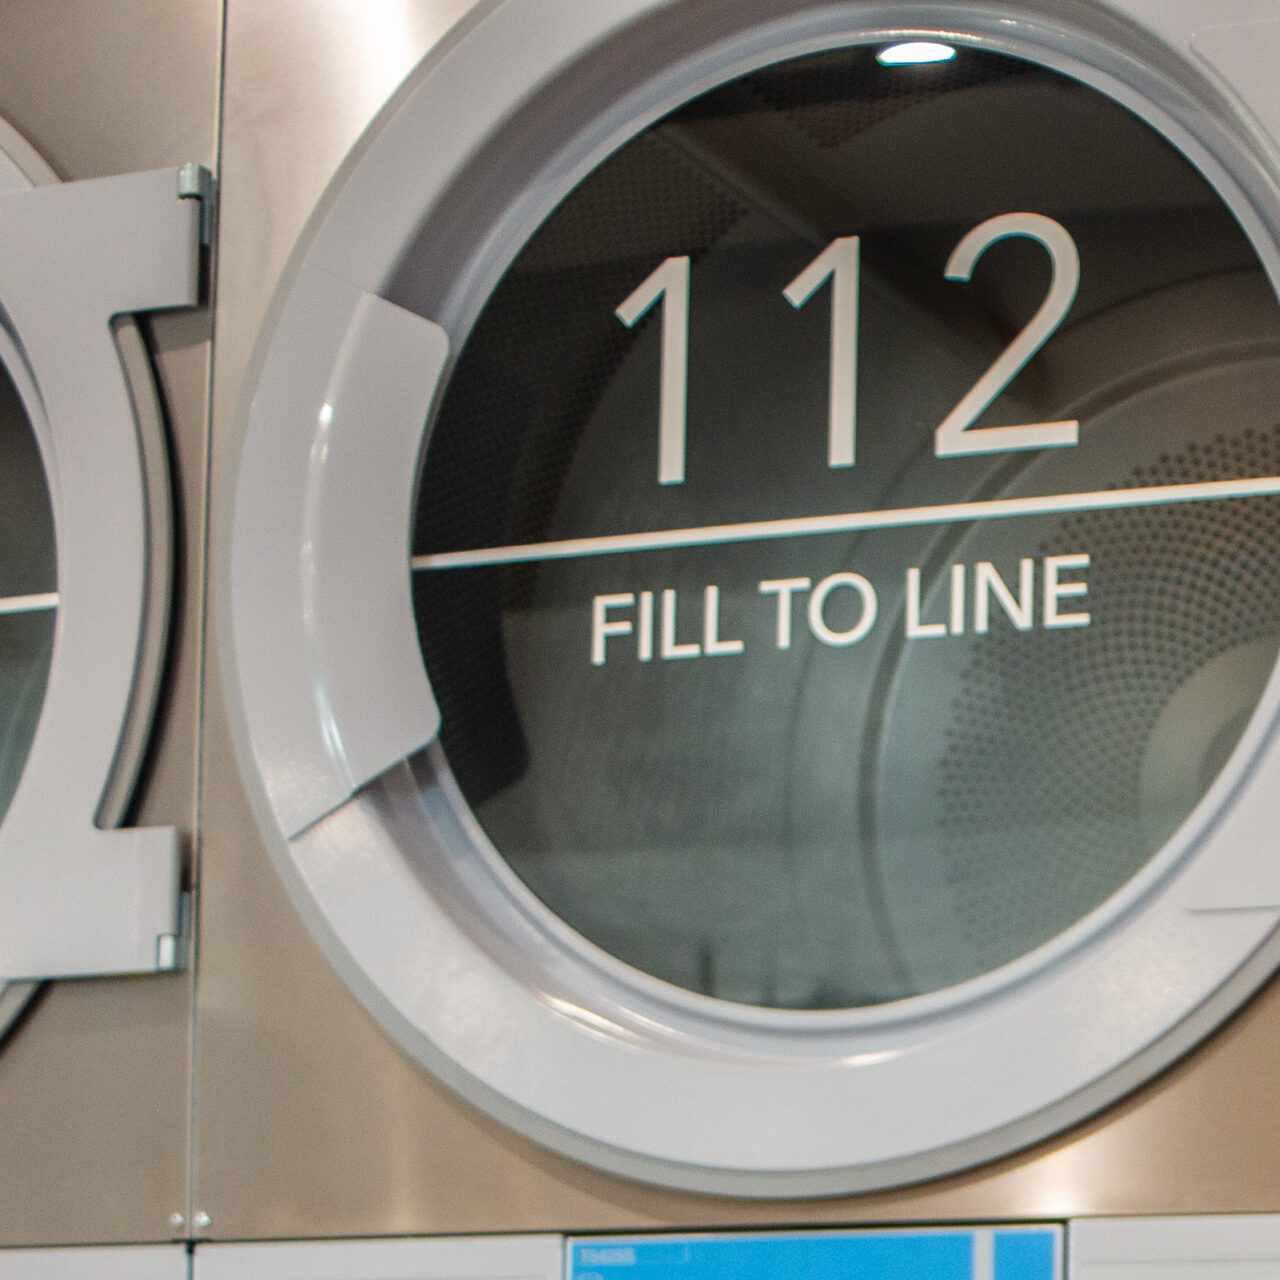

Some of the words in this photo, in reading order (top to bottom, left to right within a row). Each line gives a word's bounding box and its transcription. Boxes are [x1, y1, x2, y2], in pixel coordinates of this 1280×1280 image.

[615, 212, 1081, 485] 112
[591, 584, 745, 665] FILL
[758, 571, 878, 649] TO
[905, 552, 1092, 639] LINE
